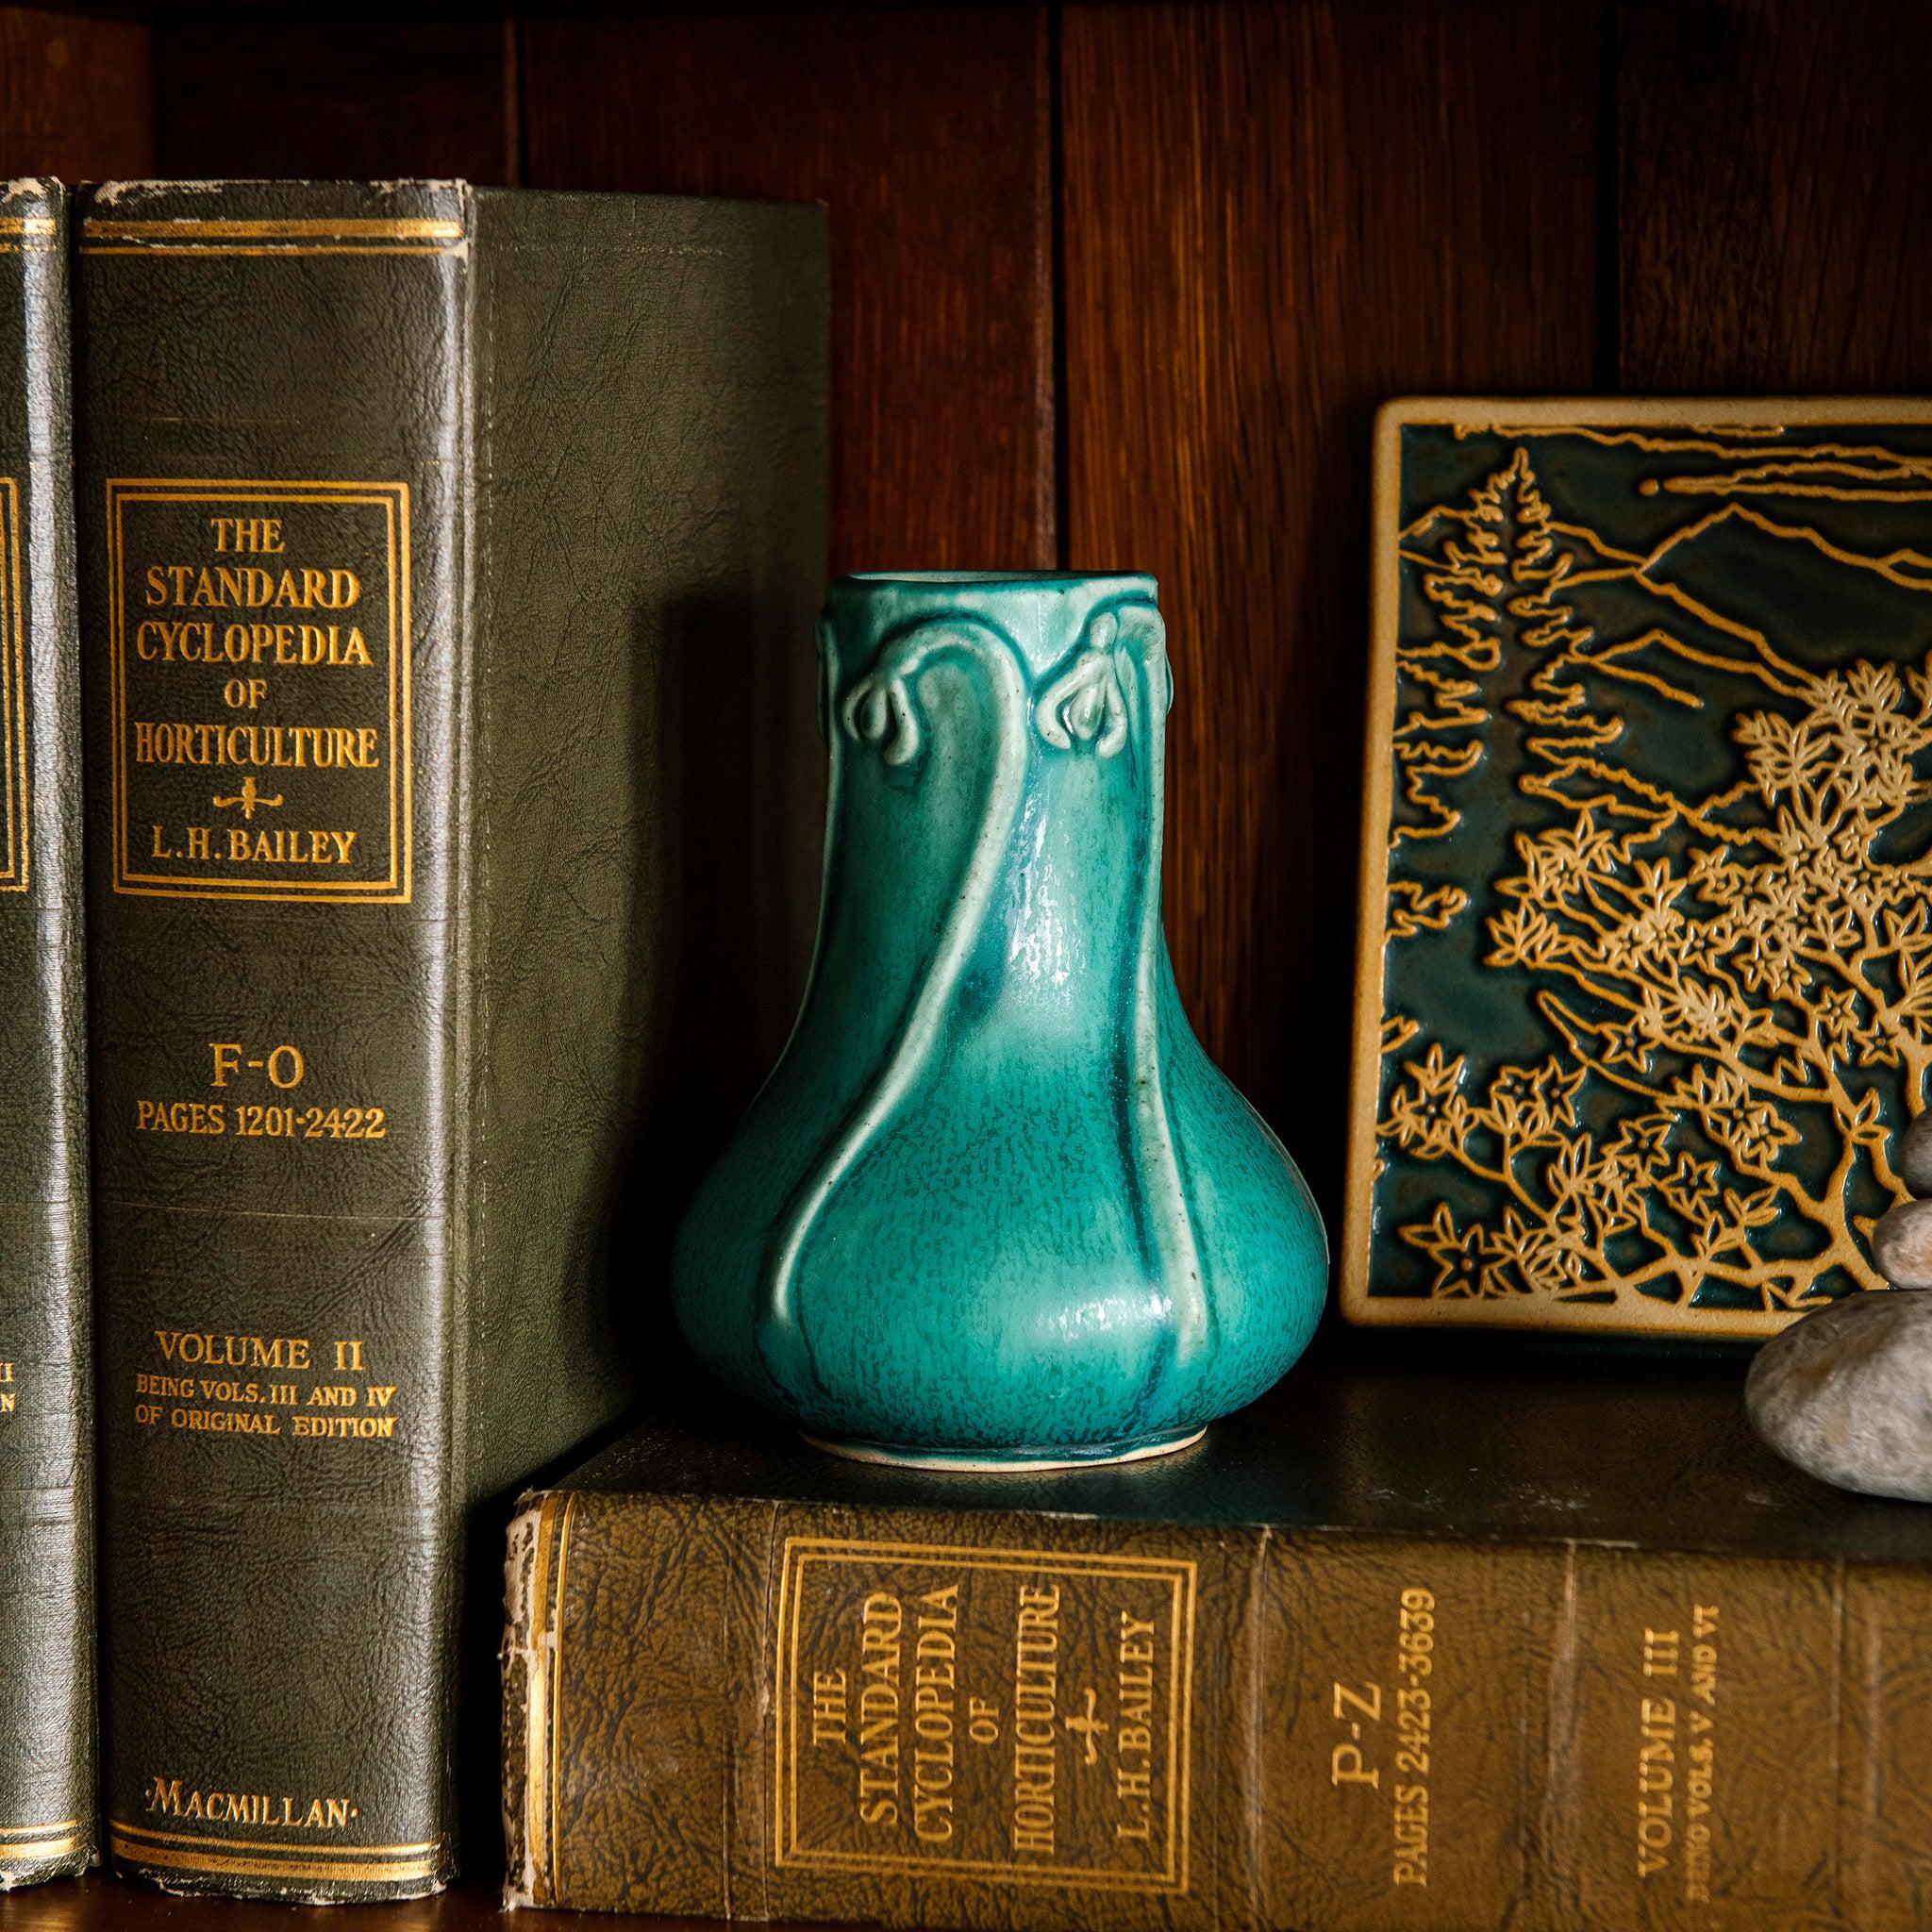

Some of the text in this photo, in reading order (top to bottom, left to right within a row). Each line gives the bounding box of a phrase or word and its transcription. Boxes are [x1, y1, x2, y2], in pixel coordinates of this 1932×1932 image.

[211, 518, 285, 554] THE
[145, 566, 360, 608] STANDARD
[137, 622, 374, 666] CYCLOPEDIA
[225, 679, 268, 708] OF
[134, 722, 379, 768] HORTICULTURE
[209, 1042, 305, 1090] F-O
[137, 1100, 386, 1139] PAGES 1201-2422
[156, 1330, 363, 1371] VOLUME II
[136, 1374, 194, 1398] BEING
[307, 1386, 357, 1407] AND
[366, 1386, 396, 1407] IV
[136, 1404, 397, 1438] OF ORIGINAL EDITION
[1691, 1645, 1717, 1706] AND
[813, 1669, 846, 1746] THE
[859, 1592, 903, 1826] STANDARD
[914, 1584, 958, 1843] CYCLOPEDIA
[969, 1696, 1000, 1745] OF
[1014, 1584, 1060, 1855] HORTICULTURE
[1690, 1710, 1714, 1735] V
[1331, 1681, 1381, 1790] P-Z
[1393, 1586, 1435, 1887] PAGES 2423-3639
[1638, 1627, 1679, 1878] VOLUME III
